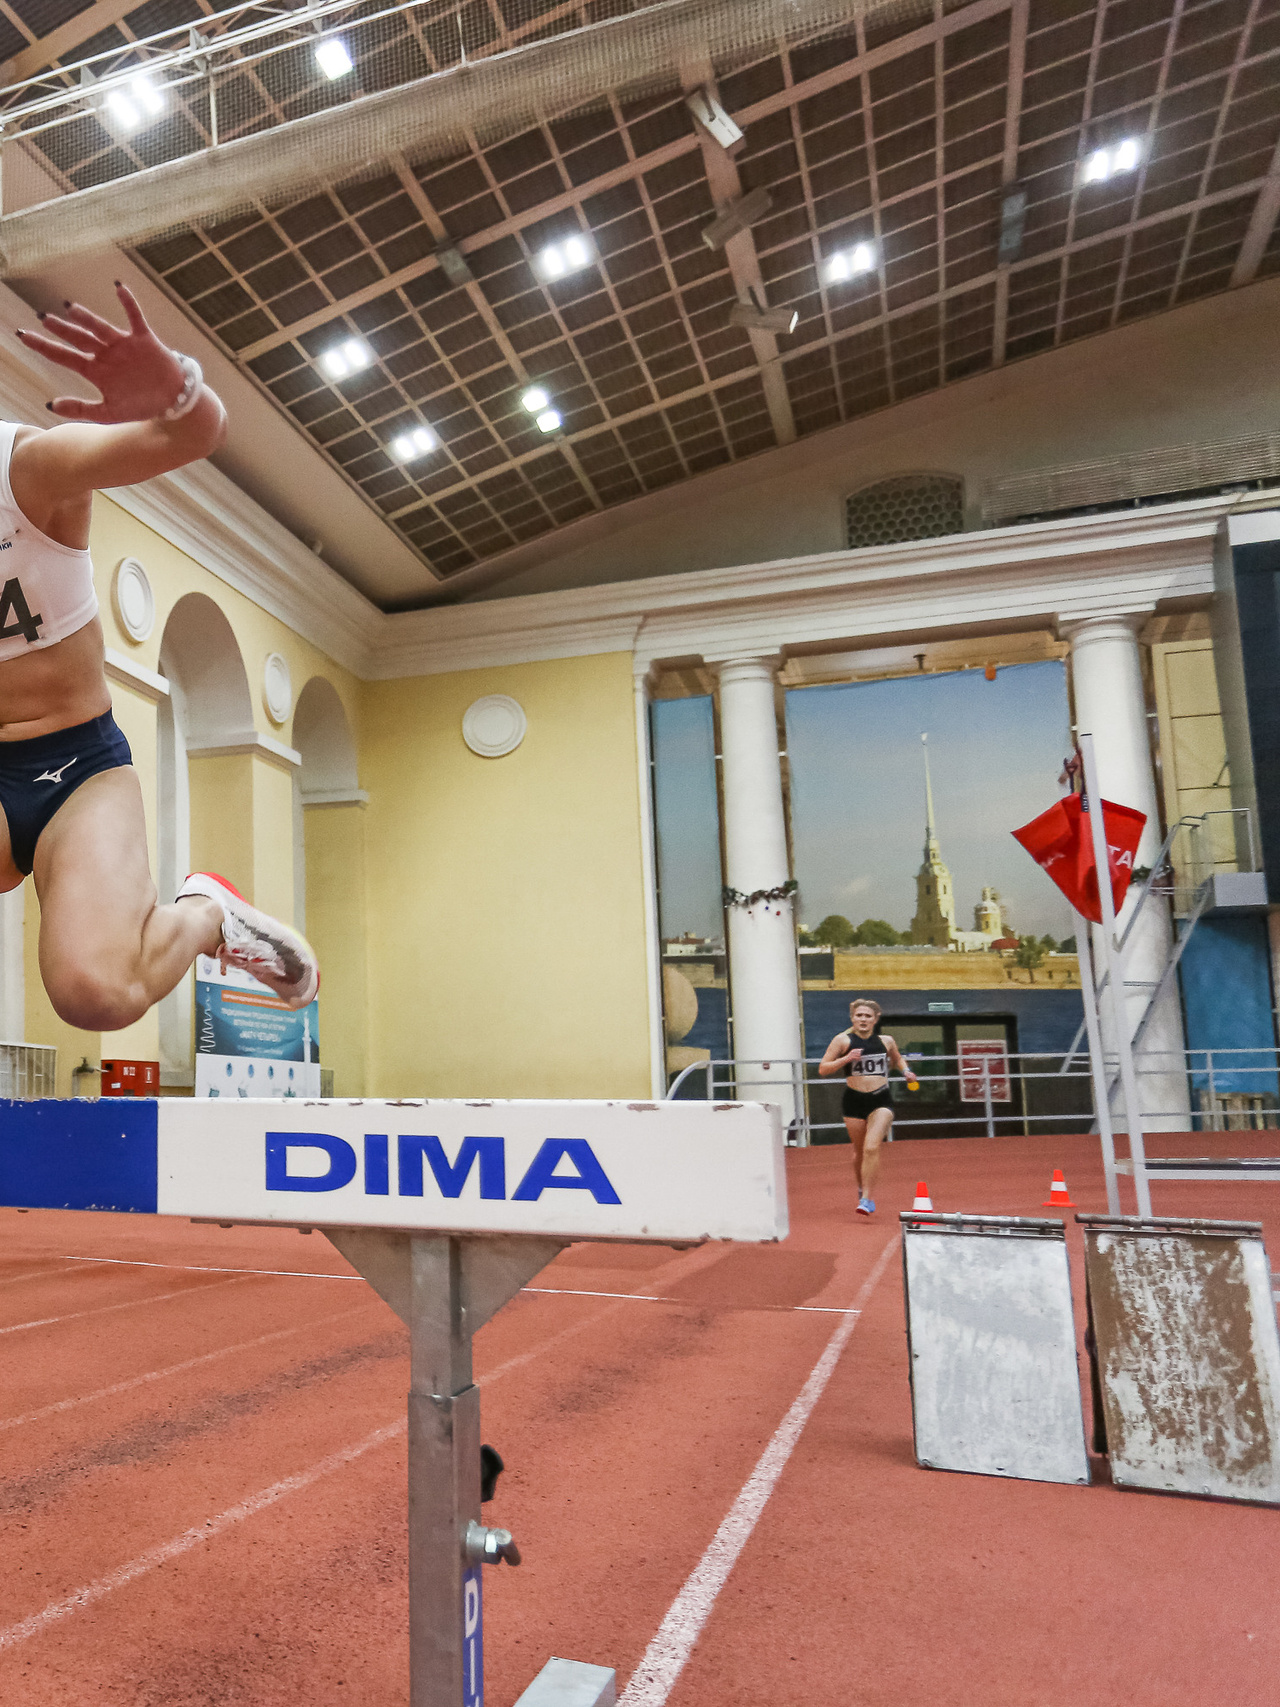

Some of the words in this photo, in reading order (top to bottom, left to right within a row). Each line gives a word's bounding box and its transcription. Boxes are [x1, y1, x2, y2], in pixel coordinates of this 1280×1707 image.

[852, 1058, 884, 1074] 401
[265, 1131, 623, 1205] DIMA
[464, 1577, 480, 1707] DI
